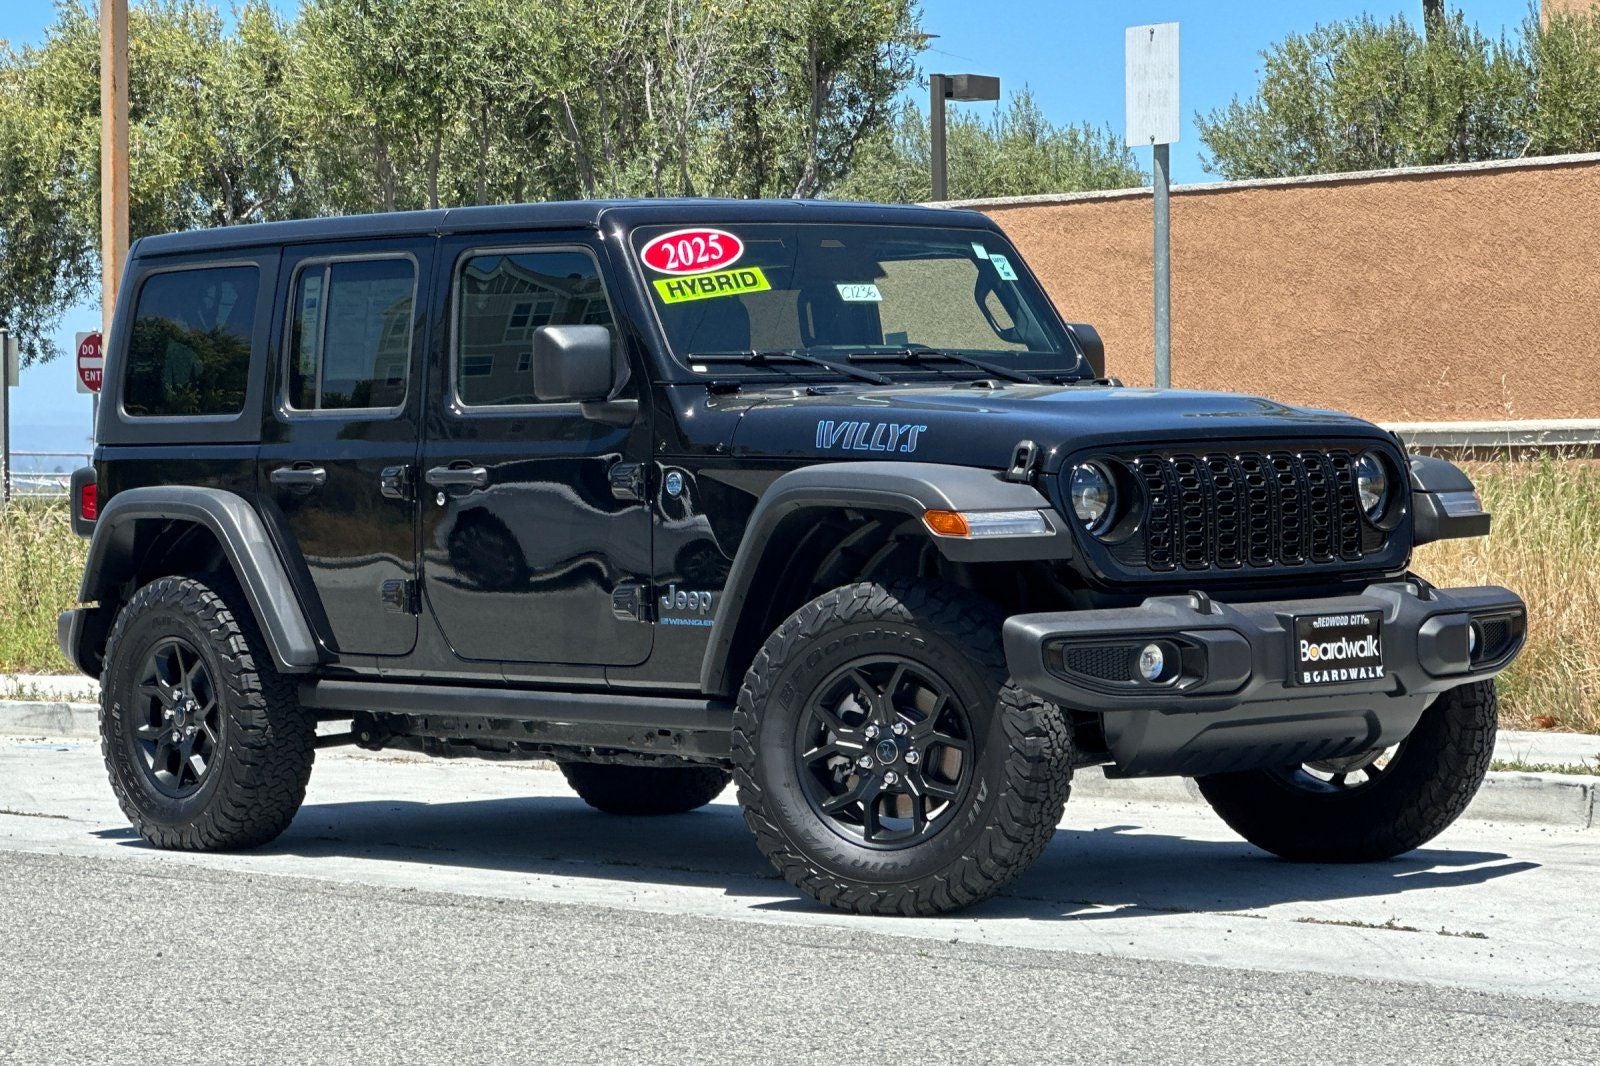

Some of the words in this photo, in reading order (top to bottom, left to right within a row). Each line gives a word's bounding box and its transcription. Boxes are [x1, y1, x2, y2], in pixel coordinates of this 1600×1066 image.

[661, 233, 724, 270] 2025
[665, 270, 758, 299] HYBRID
[82, 344, 94, 355] DO
[84, 370, 101, 381] ENT
[815, 420, 928, 452] WILLYS
[661, 584, 713, 615] Jeep
[1317, 615, 1349, 628] REDWOOD
[1350, 614, 1366, 626] CITY
[1300, 635, 1379, 661] Boardwalk
[1303, 665, 1385, 684] BOARDWALK
